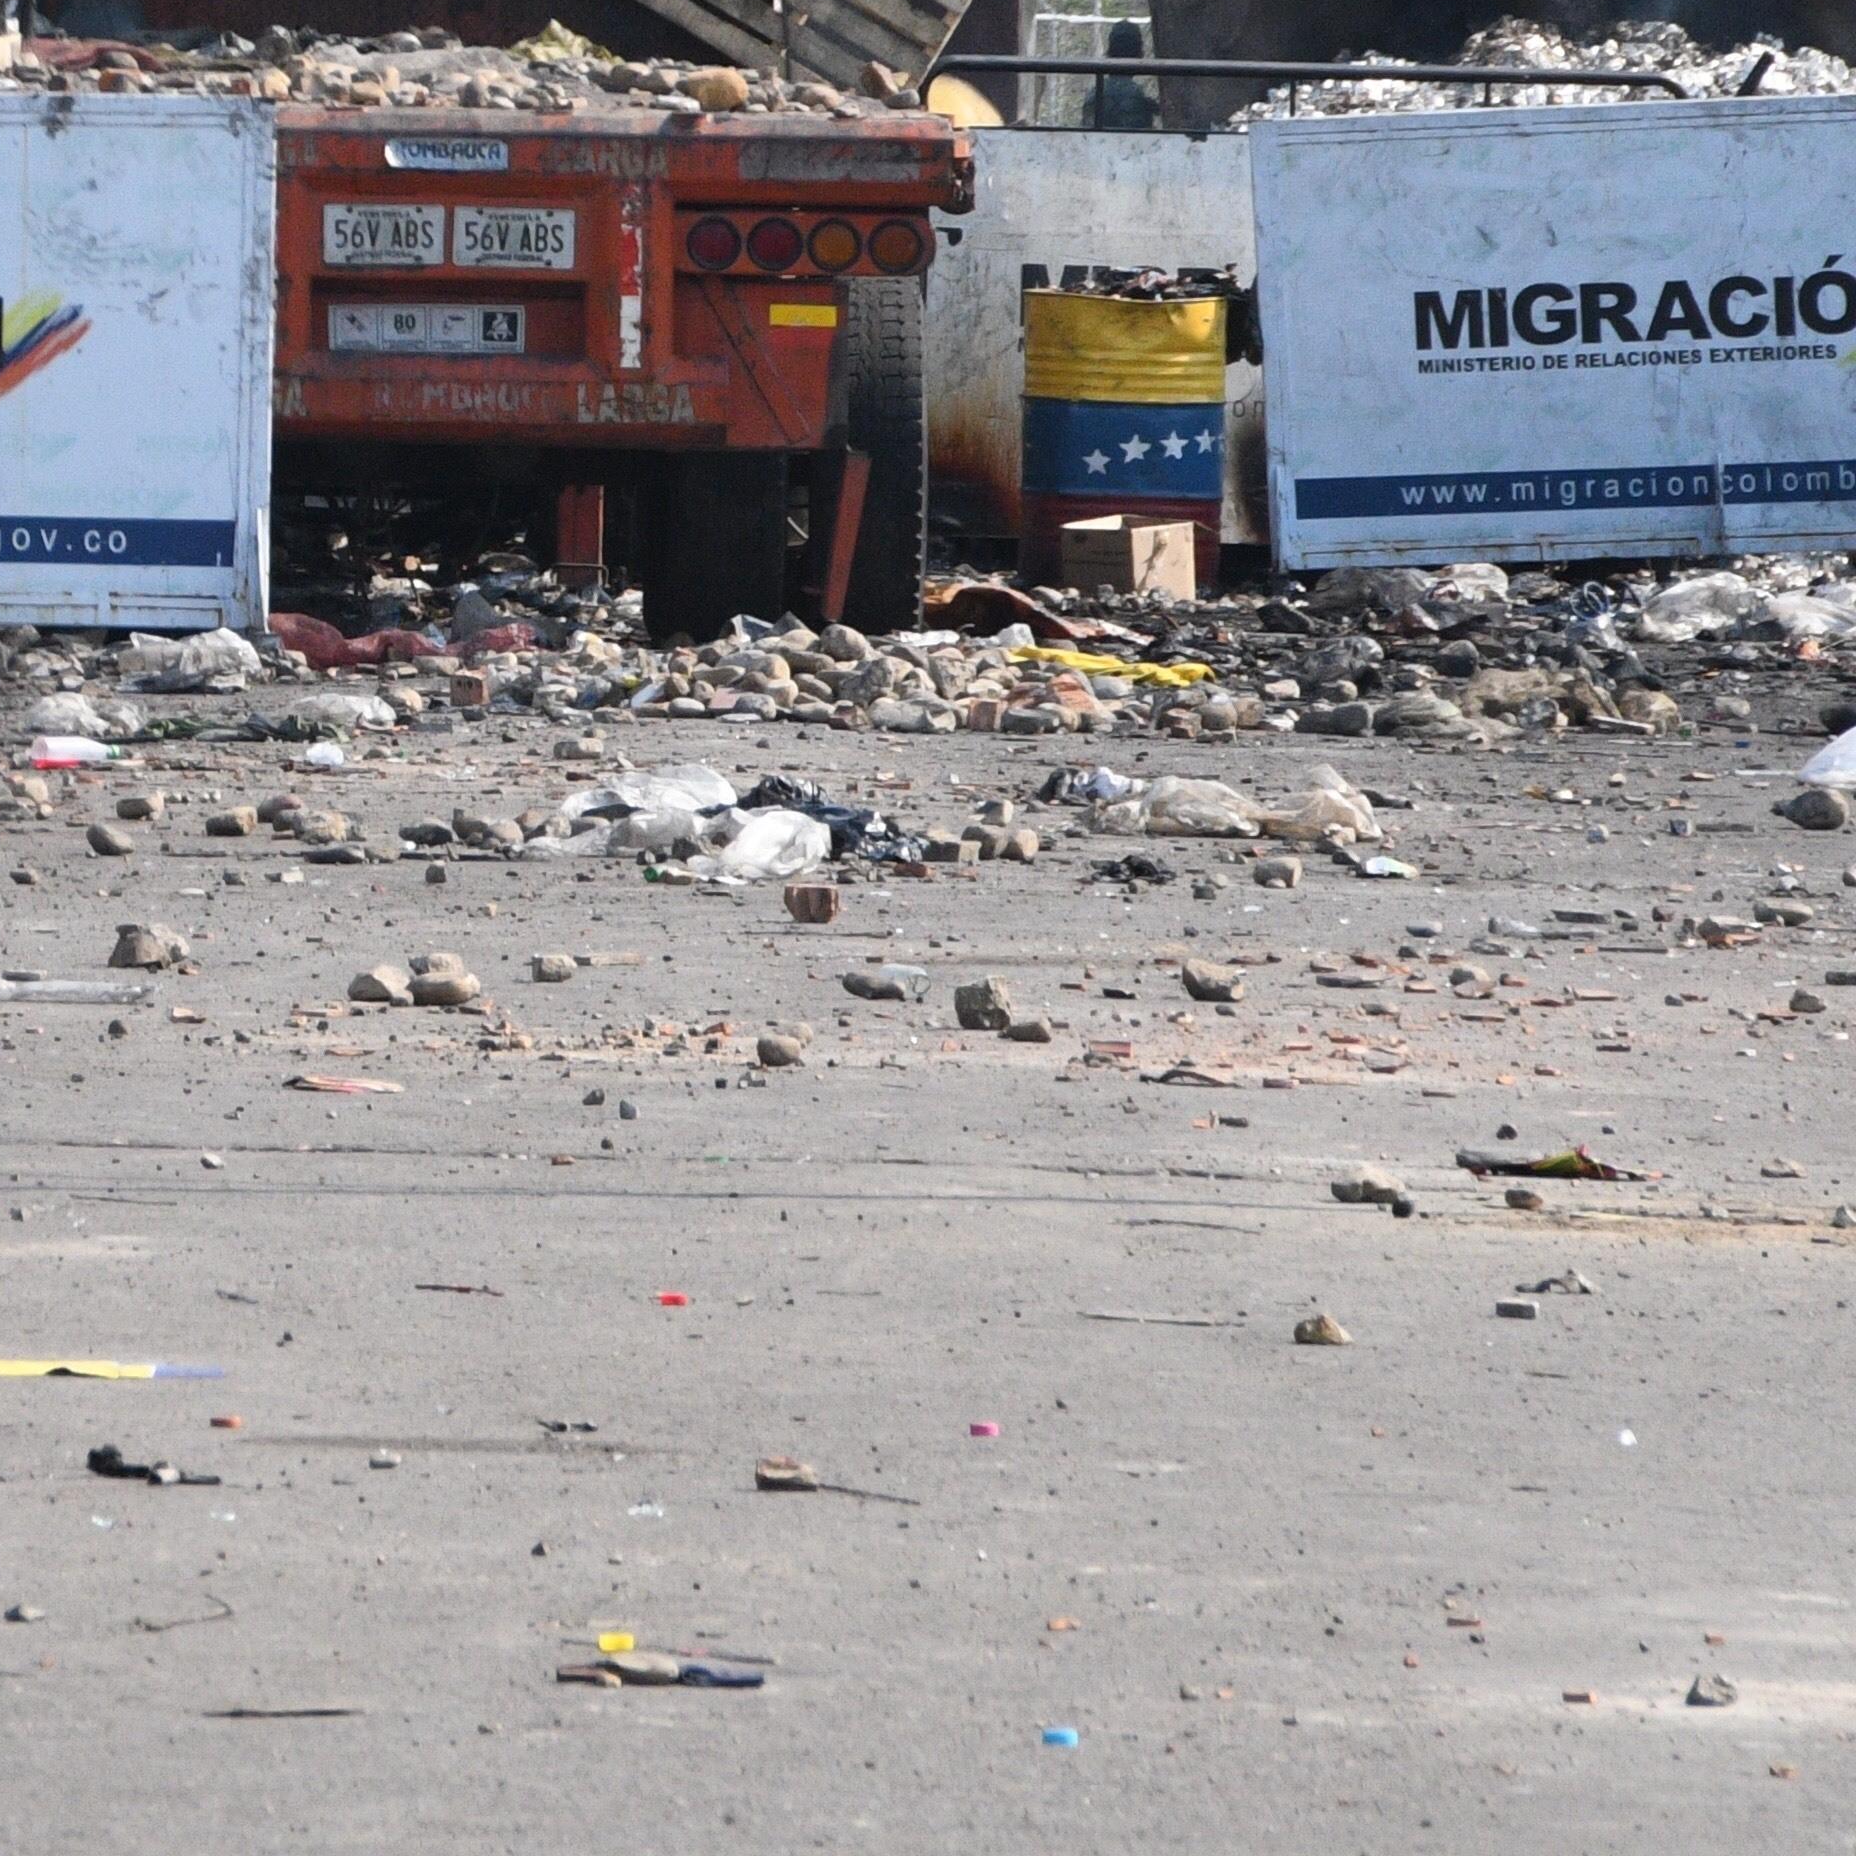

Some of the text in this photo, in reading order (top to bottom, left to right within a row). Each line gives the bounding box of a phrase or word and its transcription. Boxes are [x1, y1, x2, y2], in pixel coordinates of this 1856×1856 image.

[334, 219, 435, 250] 56V ABS
[464, 221, 566, 254] 56V ABS
[393, 313, 417, 331] 80
[1417, 344, 1837, 374] MINISTERIO DE RELACIONES EXTERIORES
[576, 382, 696, 424] LARGA
